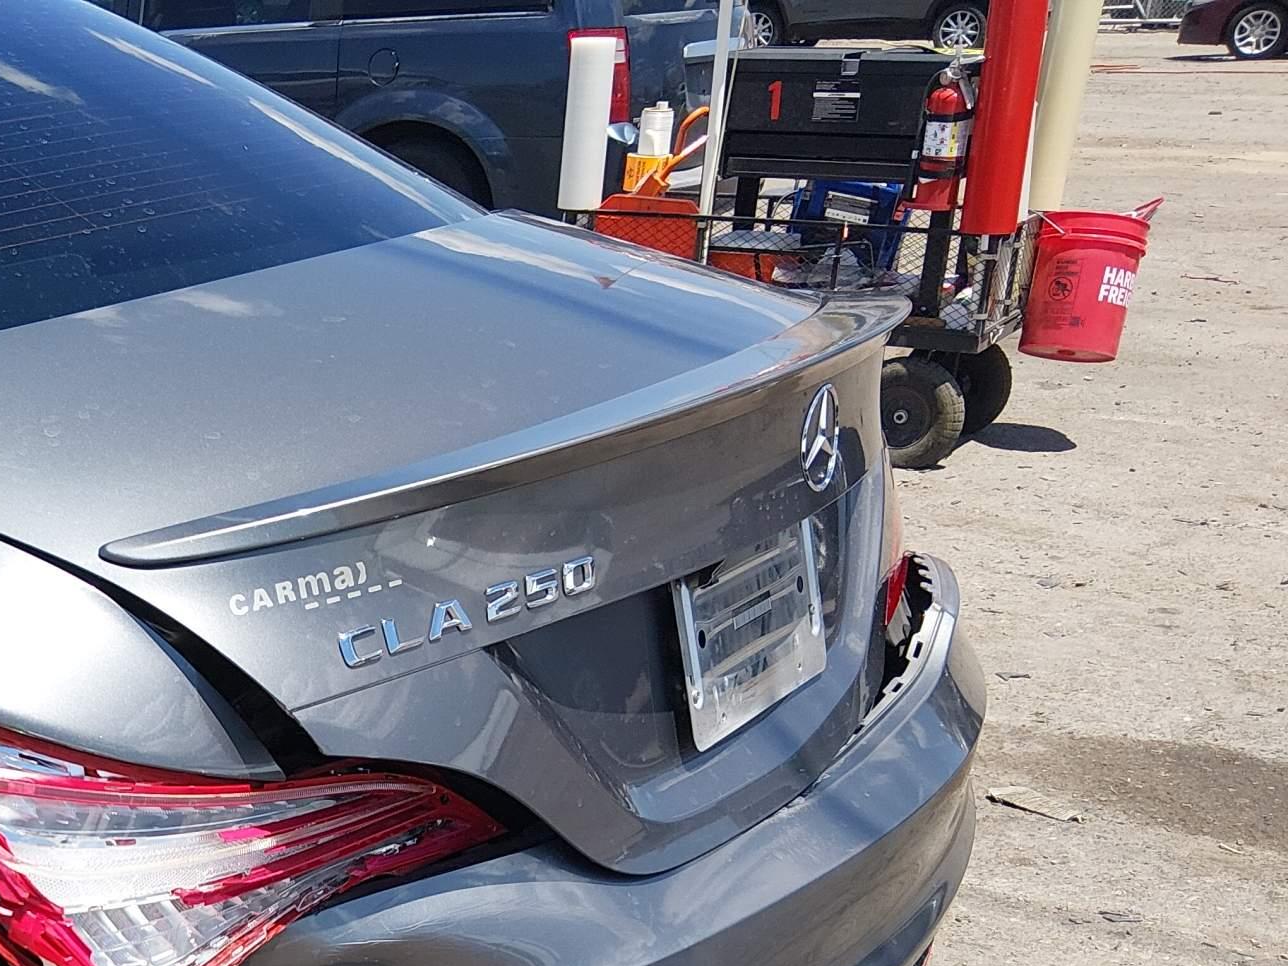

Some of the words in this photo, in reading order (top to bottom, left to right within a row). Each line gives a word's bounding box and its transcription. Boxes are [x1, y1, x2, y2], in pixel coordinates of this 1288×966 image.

[768, 80, 782, 121] 1
[338, 600, 473, 669] CLA
[485, 555, 596, 623] 250
